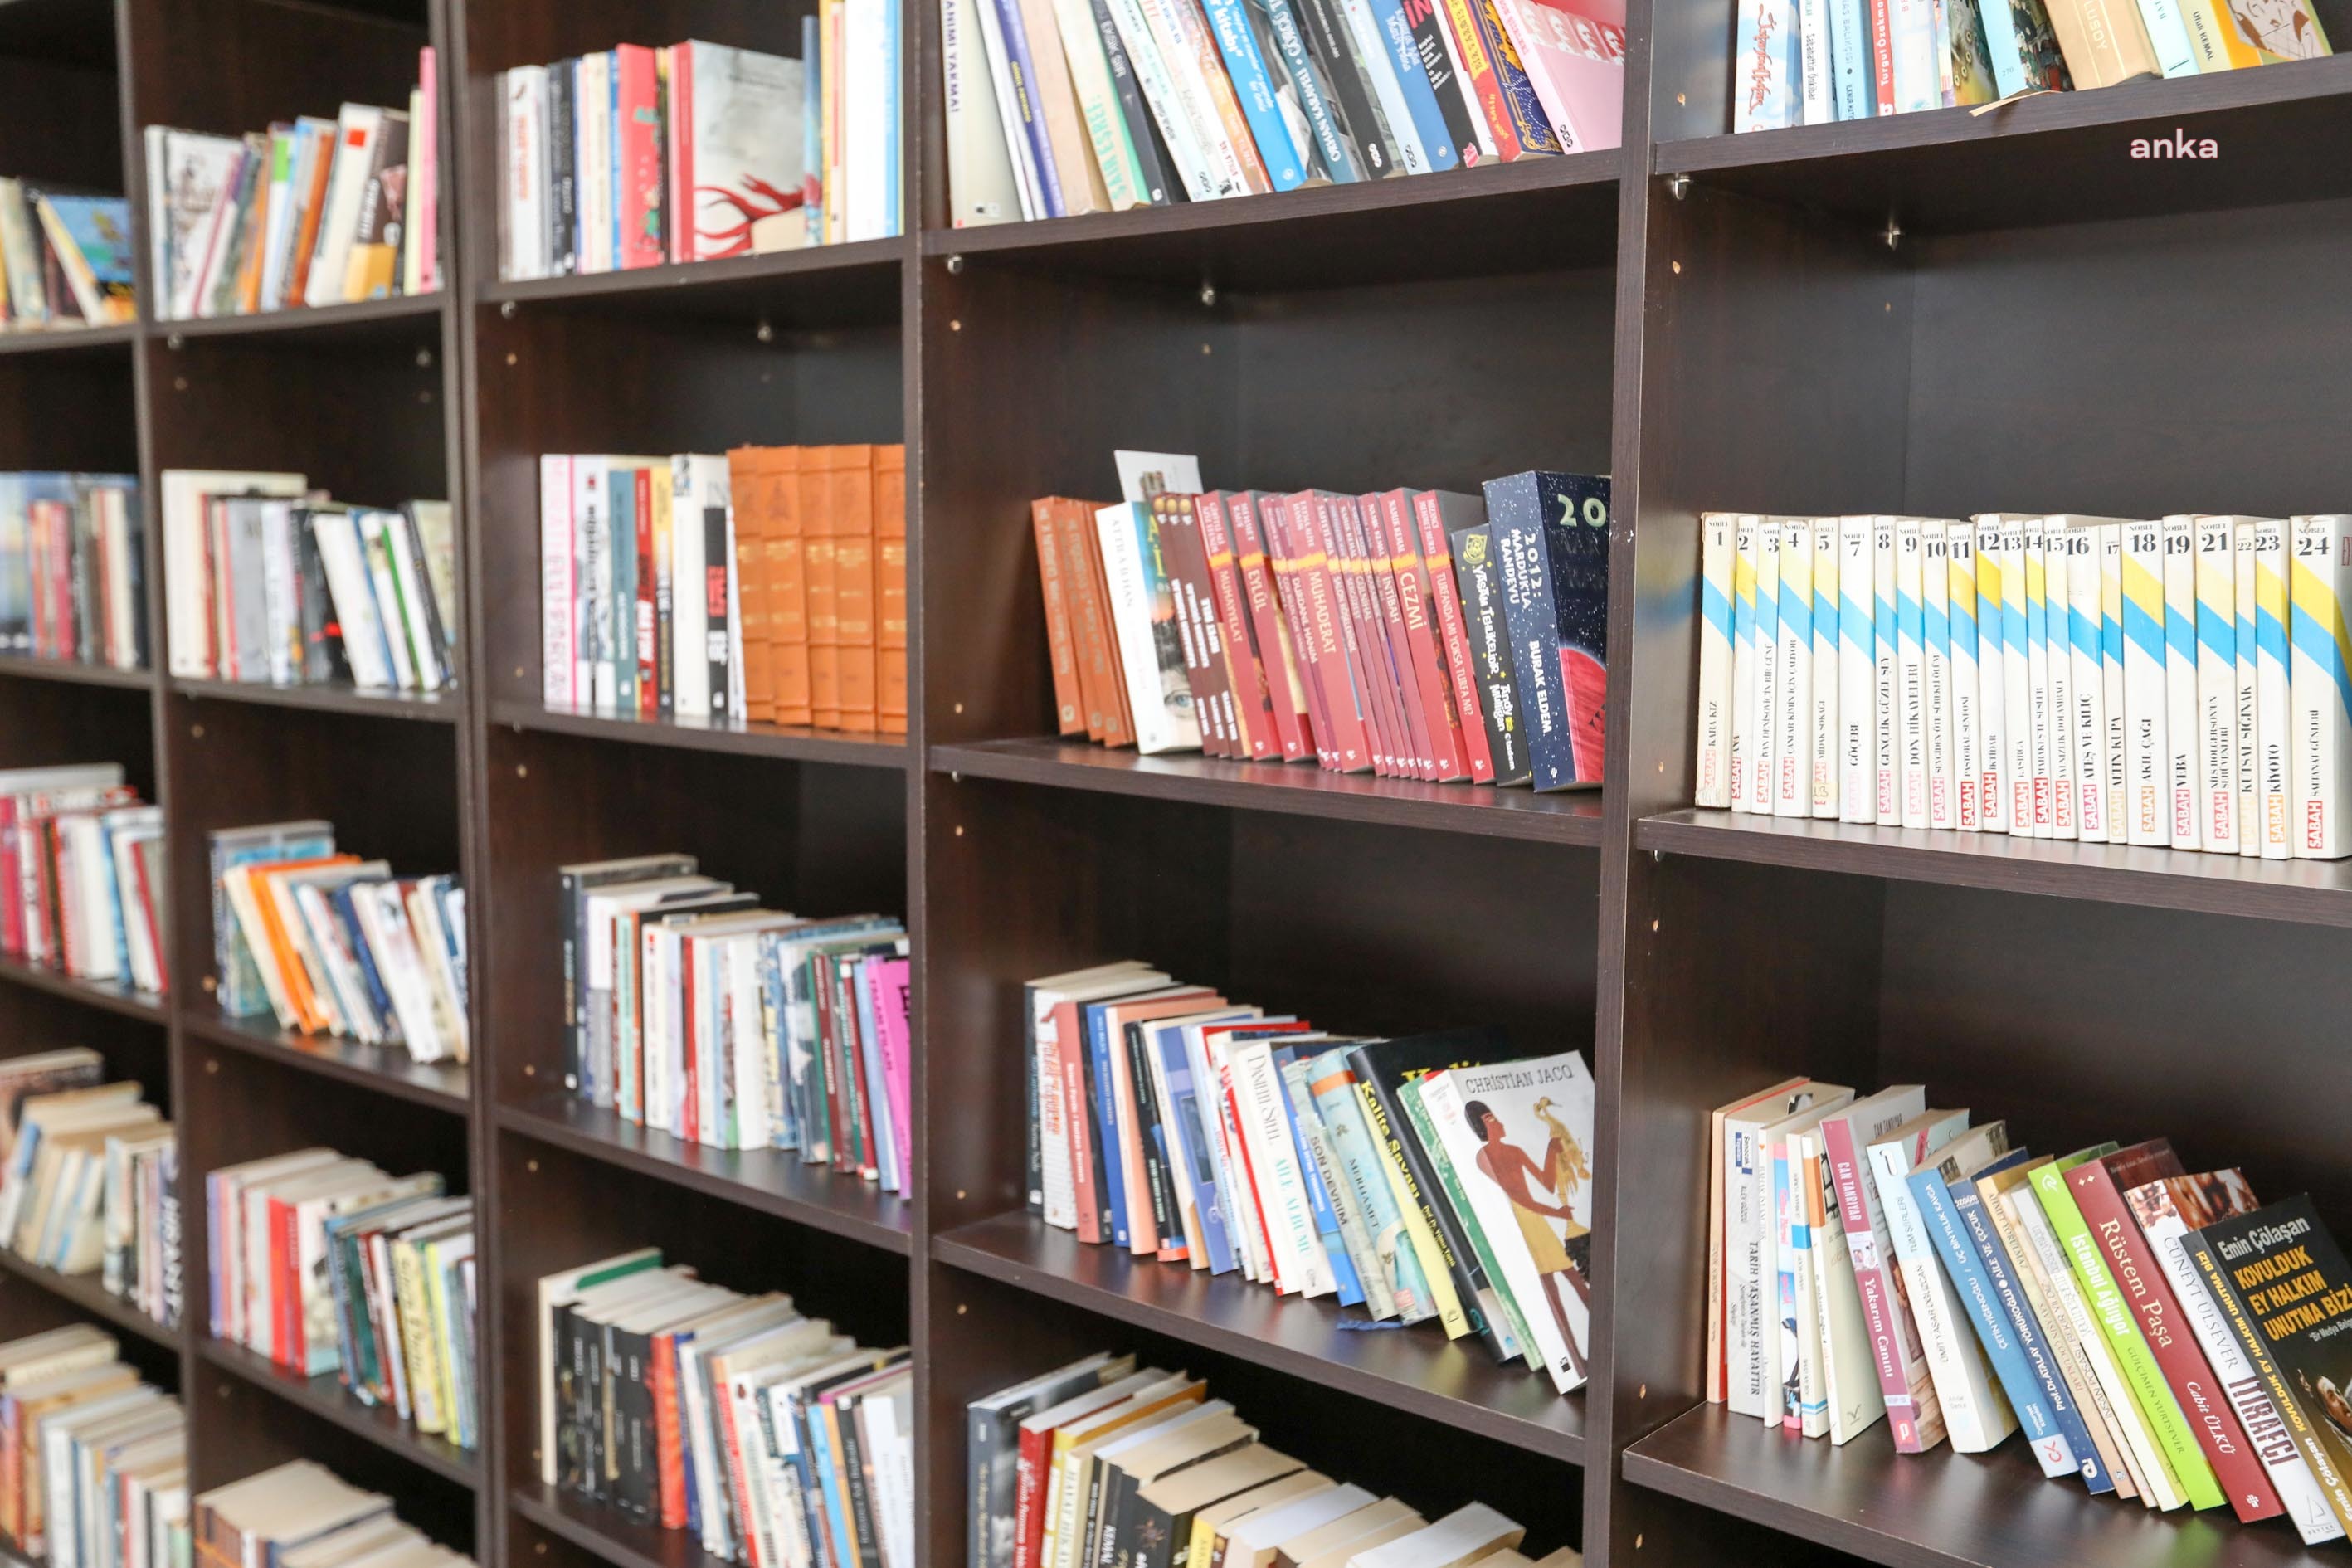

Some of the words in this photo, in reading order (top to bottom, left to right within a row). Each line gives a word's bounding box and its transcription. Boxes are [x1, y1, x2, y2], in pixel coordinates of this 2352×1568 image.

[1806, 33, 1815, 71] Sabahattin
[2200, 32, 2214, 61] KEMAL
[1880, 50, 1889, 86] Turgut
[1808, 73, 1819, 100] Önkibar
[1316, 118, 1343, 163] ORHAN
[1556, 493, 1607, 528] 20
[1717, 531, 1722, 546] 1
[1738, 535, 1749, 551] 2
[1768, 537, 1780, 553] 3
[1787, 532, 1799, 548] 4
[1819, 535, 1829, 551] 5
[1850, 541, 1861, 557] 7
[1878, 533, 1890, 550] 8
[1905, 537, 1917, 552] 9
[1926, 541, 1947, 558] 10
[1950, 541, 1970, 559] 11
[1977, 533, 2000, 551] 12
[2003, 536, 2022, 551] 13
[2025, 534, 2043, 549] 14
[2045, 538, 2064, 553] 15
[2067, 537, 2090, 555] 16
[2106, 544, 2119, 555] 17
[2131, 533, 2157, 553] 18
[2164, 535, 2190, 555] 19
[2200, 532, 2228, 553] 21
[2237, 541, 2252, 551] 22
[2256, 535, 2280, 552] 23
[2297, 536, 2330, 557] 24
[1499, 538, 1521, 605] RANDEVU
[1509, 528, 1534, 610] MARDUK'LA
[1522, 533, 1546, 599] 2012:
[1218, 569, 1243, 644] MUHAYYELAT
[1247, 568, 1269, 613] EYLÜL
[1382, 576, 1400, 624] İNTİBAH
[1399, 570, 1427, 631] CEZMİ
[1435, 572, 1454, 623] TURFANDA
[1307, 570, 1337, 655] MUHADERAT
[1445, 622, 1456, 636] MI
[1448, 635, 1463, 667] YOKSA
[1527, 640, 1546, 689] BURAK
[1455, 666, 1470, 698] TURFA
[1879, 679, 1889, 714] GÜZEL
[1906, 664, 1919, 734] HİKAYELERİ
[1461, 697, 1475, 716] MI?
[1488, 684, 1509, 732] Mulligan
[1498, 684, 1515, 716] Andy
[1536, 689, 1554, 733] ELDEM
[1708, 701, 1717, 718] KIZ
[2079, 694, 2093, 728] KILIÇ
[2238, 685, 2252, 739] SIĞINAK
[1708, 720, 1717, 747] KARA
[1848, 722, 1861, 766] GÖÇEBE
[1879, 718, 1892, 766] GENÇLİK
[2082, 732, 2092, 748] VE
[2111, 716, 2121, 748] KUPA
[2140, 718, 2154, 748] ÇAĞI
[1504, 740, 1517, 771] tudem
[1910, 739, 1920, 765] DON
[2083, 751, 2096, 780] ATEŞ
[2112, 752, 2122, 787] ALTIN
[2142, 752, 2151, 782] AKIL
[2240, 743, 2252, 792] KUTSAL
[2267, 744, 2281, 792] KİYOTO
[1757, 761, 1768, 802] SABAH
[2176, 754, 2187, 786] VEBA
[1879, 770, 1891, 813] SABAH
[1932, 777, 1945, 821] SABAH
[1984, 772, 1997, 817] SABAH
[2034, 777, 2049, 823] SABAH
[2083, 784, 2098, 829] SABAH
[2141, 786, 2155, 832] SABAH
[2214, 791, 2229, 839] SABAH
[2307, 801, 2322, 849] SABAH
[1536, 1065, 1575, 1085] JACQ
[1359, 1079, 1390, 1140] Kalite
[1274, 1156, 1298, 1191] AİLE
[1307, 1135, 1329, 1167] SON
[1319, 1168, 1352, 1226] DEVRİM
[1838, 1161, 1853, 1181] CAN
[1344, 1157, 1385, 1230] MERHAMET
[1841, 1180, 1863, 1222] TANRIYAR
[1923, 1182, 1944, 1214] KAVGA
[1936, 1211, 1955, 1236] YILLIK
[1967, 1209, 1989, 1242] ÇOCUK
[2217, 1235, 2253, 1261] Emin
[2248, 1216, 2311, 1254] Çölaşan
[1749, 1241, 1760, 1275] TARİH
[1946, 1233, 1961, 1251] BİN
[1955, 1249, 1969, 1264] ÜÇ
[1982, 1242, 1994, 1257] VE
[1988, 1256, 2005, 1280] AİLE
[2195, 1250, 2214, 1272] BİZİ
[2233, 1244, 2314, 1290] KOVULDUK
[2068, 1231, 2108, 1291] İstanbul
[2091, 1285, 2132, 1341] Ağlıyor
[2097, 1215, 2154, 1301] Rüstem
[2137, 1297, 2178, 1351] Paşa
[2209, 1272, 2240, 1317] UNUTMA
[2248, 1290, 2272, 1317] EY
[2267, 1269, 2328, 1308] HALKIM
[1748, 1279, 1760, 1337] YAŞANMIŞ
[1965, 1276, 1996, 1326] YİĞENOĞLU
[2001, 1286, 2034, 1345] YÖRÜKOĞLU
[2161, 1232, 2205, 1303] CÜNEYT
[2195, 1298, 2241, 1372] ÜLSEVER
[1863, 1278, 1887, 1334] Yakarım
[1876, 1334, 1897, 1379] Canını
[1989, 1320, 2010, 1351] ÇETİN
[2235, 1317, 2264, 1358] HALKIM
[2262, 1302, 2327, 1342] UNUTMA
[1750, 1341, 1760, 1395] HAYATTIR
[2029, 1344, 2067, 1412] Prof.Dr.ATALAY
[2259, 1357, 2274, 1376] EY
[2126, 1344, 2160, 1401] GÜLÇİMEN
[2152, 1397, 2188, 1457] YURTSEVER
[2267, 1376, 2308, 1433] KOVULDUK
[2184, 1378, 2213, 1416] Cahit
[2203, 1410, 2236, 1459] ÜLKÜ
[2304, 1436, 2340, 1489] Çölaşan
